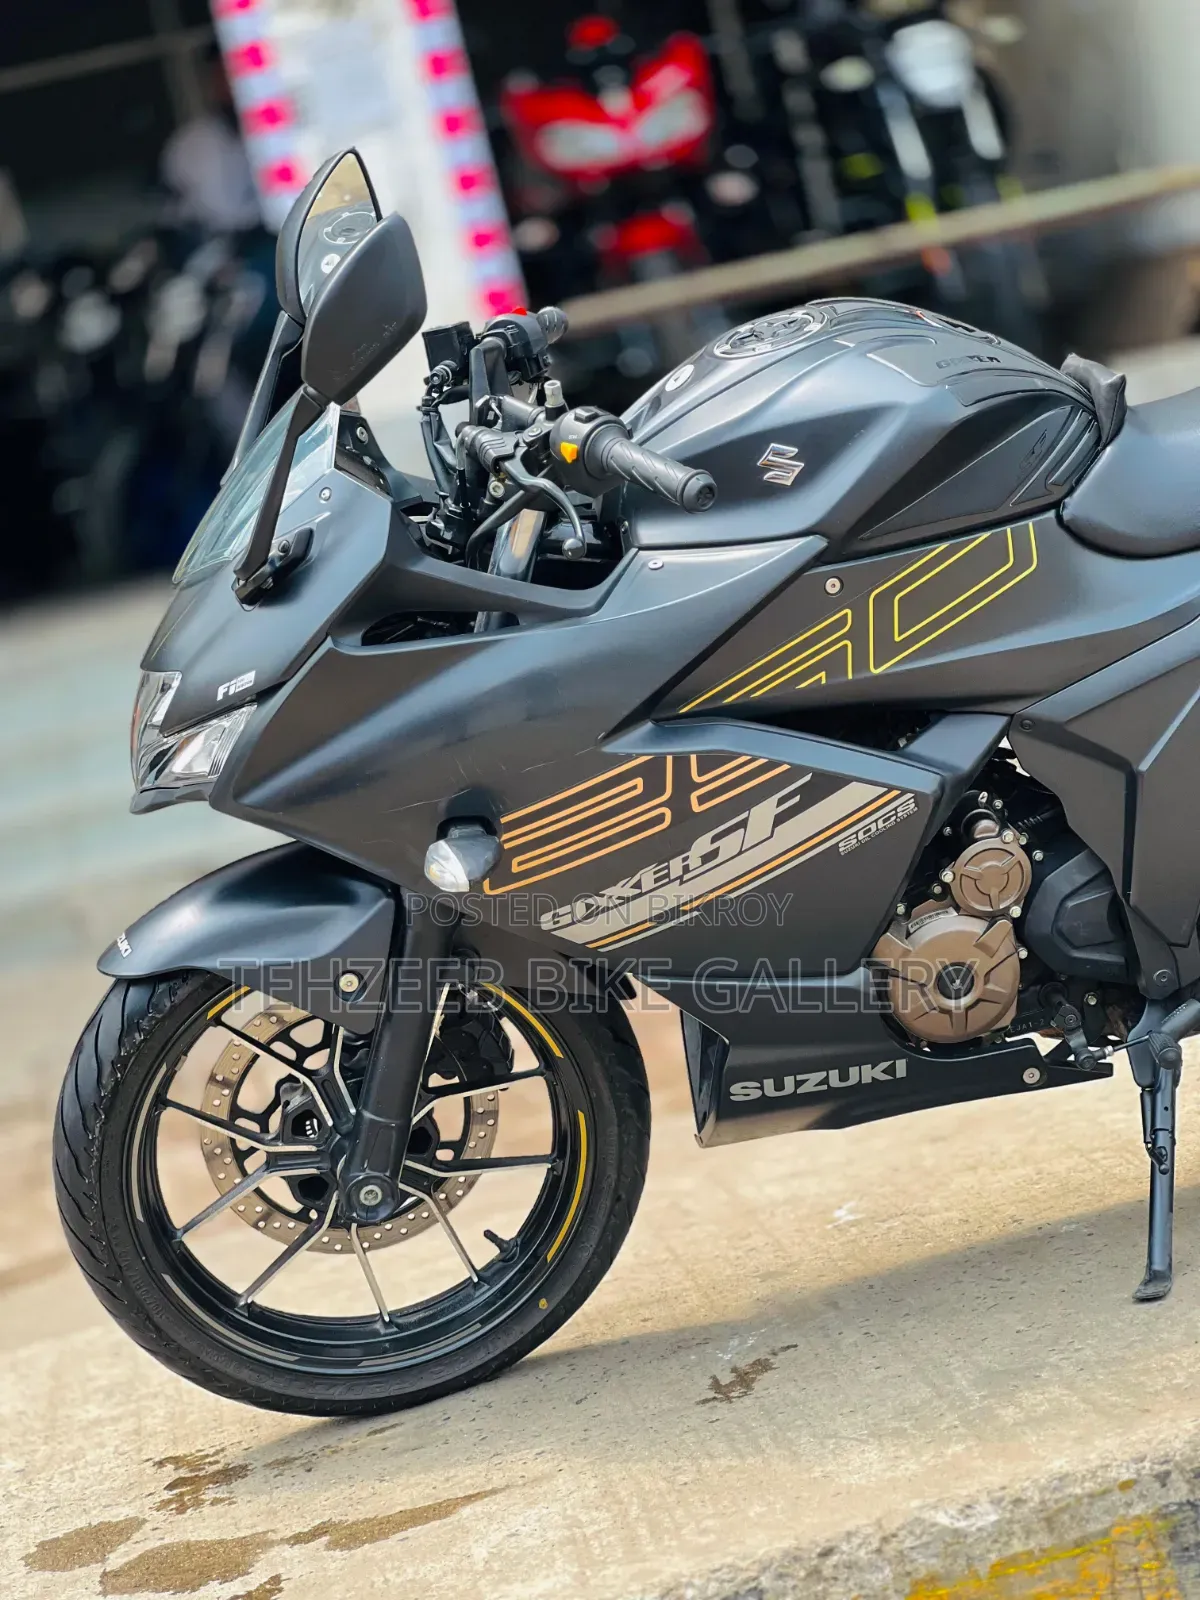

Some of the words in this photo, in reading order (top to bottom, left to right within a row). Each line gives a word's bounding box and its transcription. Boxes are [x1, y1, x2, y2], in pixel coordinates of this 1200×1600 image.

[838, 798, 916, 852] SOCS
[870, 820, 896, 838] COOLING
[896, 806, 919, 822] SYSTEM
[729, 1058, 907, 1102] SUZUKI
